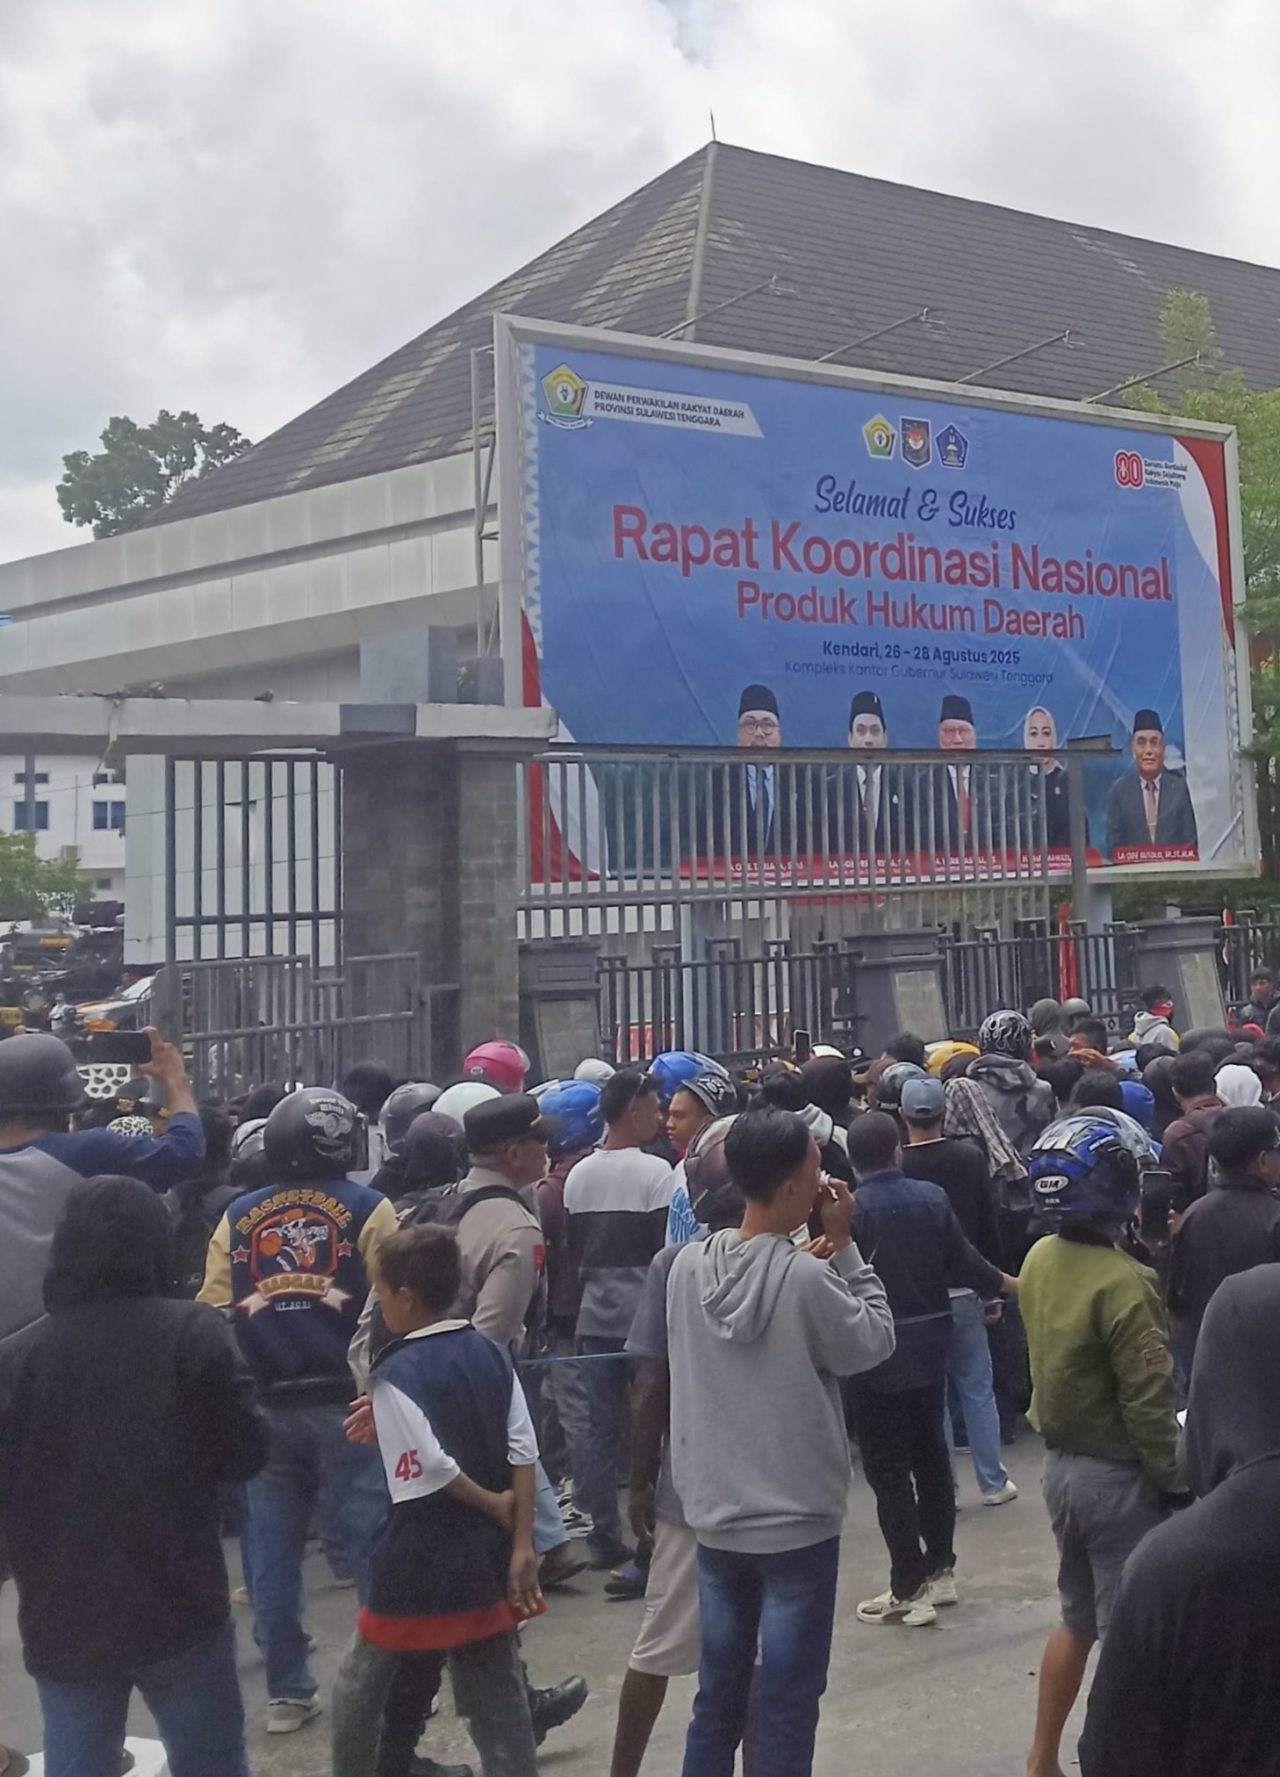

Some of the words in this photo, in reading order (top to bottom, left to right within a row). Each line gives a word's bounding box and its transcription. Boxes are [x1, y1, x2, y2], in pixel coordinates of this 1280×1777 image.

[594, 401, 634, 415] PROVINSI
[635, 407, 676, 421] SULAWESI
[677, 412, 721, 427] TENGGARA
[595, 390, 625, 403] DEWAN
[626, 394, 679, 411] PERWAKILAN
[681, 402, 712, 415] RAKYAT
[713, 407, 745, 419] DAERAH
[815, 474, 911, 520] Selamat
[917, 488, 940, 522] &
[948, 490, 1017, 531] Sukses
[613, 504, 760, 577] Rapat
[771, 518, 1001, 588] Koordinasi
[1011, 542, 1173, 601] Nasional
[737, 579, 859, 625] Produk
[866, 589, 976, 633] Hukum
[983, 597, 1086, 640] Daerah
[823, 640, 882, 660] Kendari,
[884, 643, 901, 659] 26
[913, 645, 930, 661] 28
[932, 646, 988, 666] Agustus
[989, 649, 1021, 665] 2025
[784, 660, 847, 678] Kompleks
[848, 662, 888, 677] Kantor
[890, 664, 946, 680] Gubernur
[235, 1188, 353, 1234] BASKETBALL
[394, 1449, 423, 1482] 45
